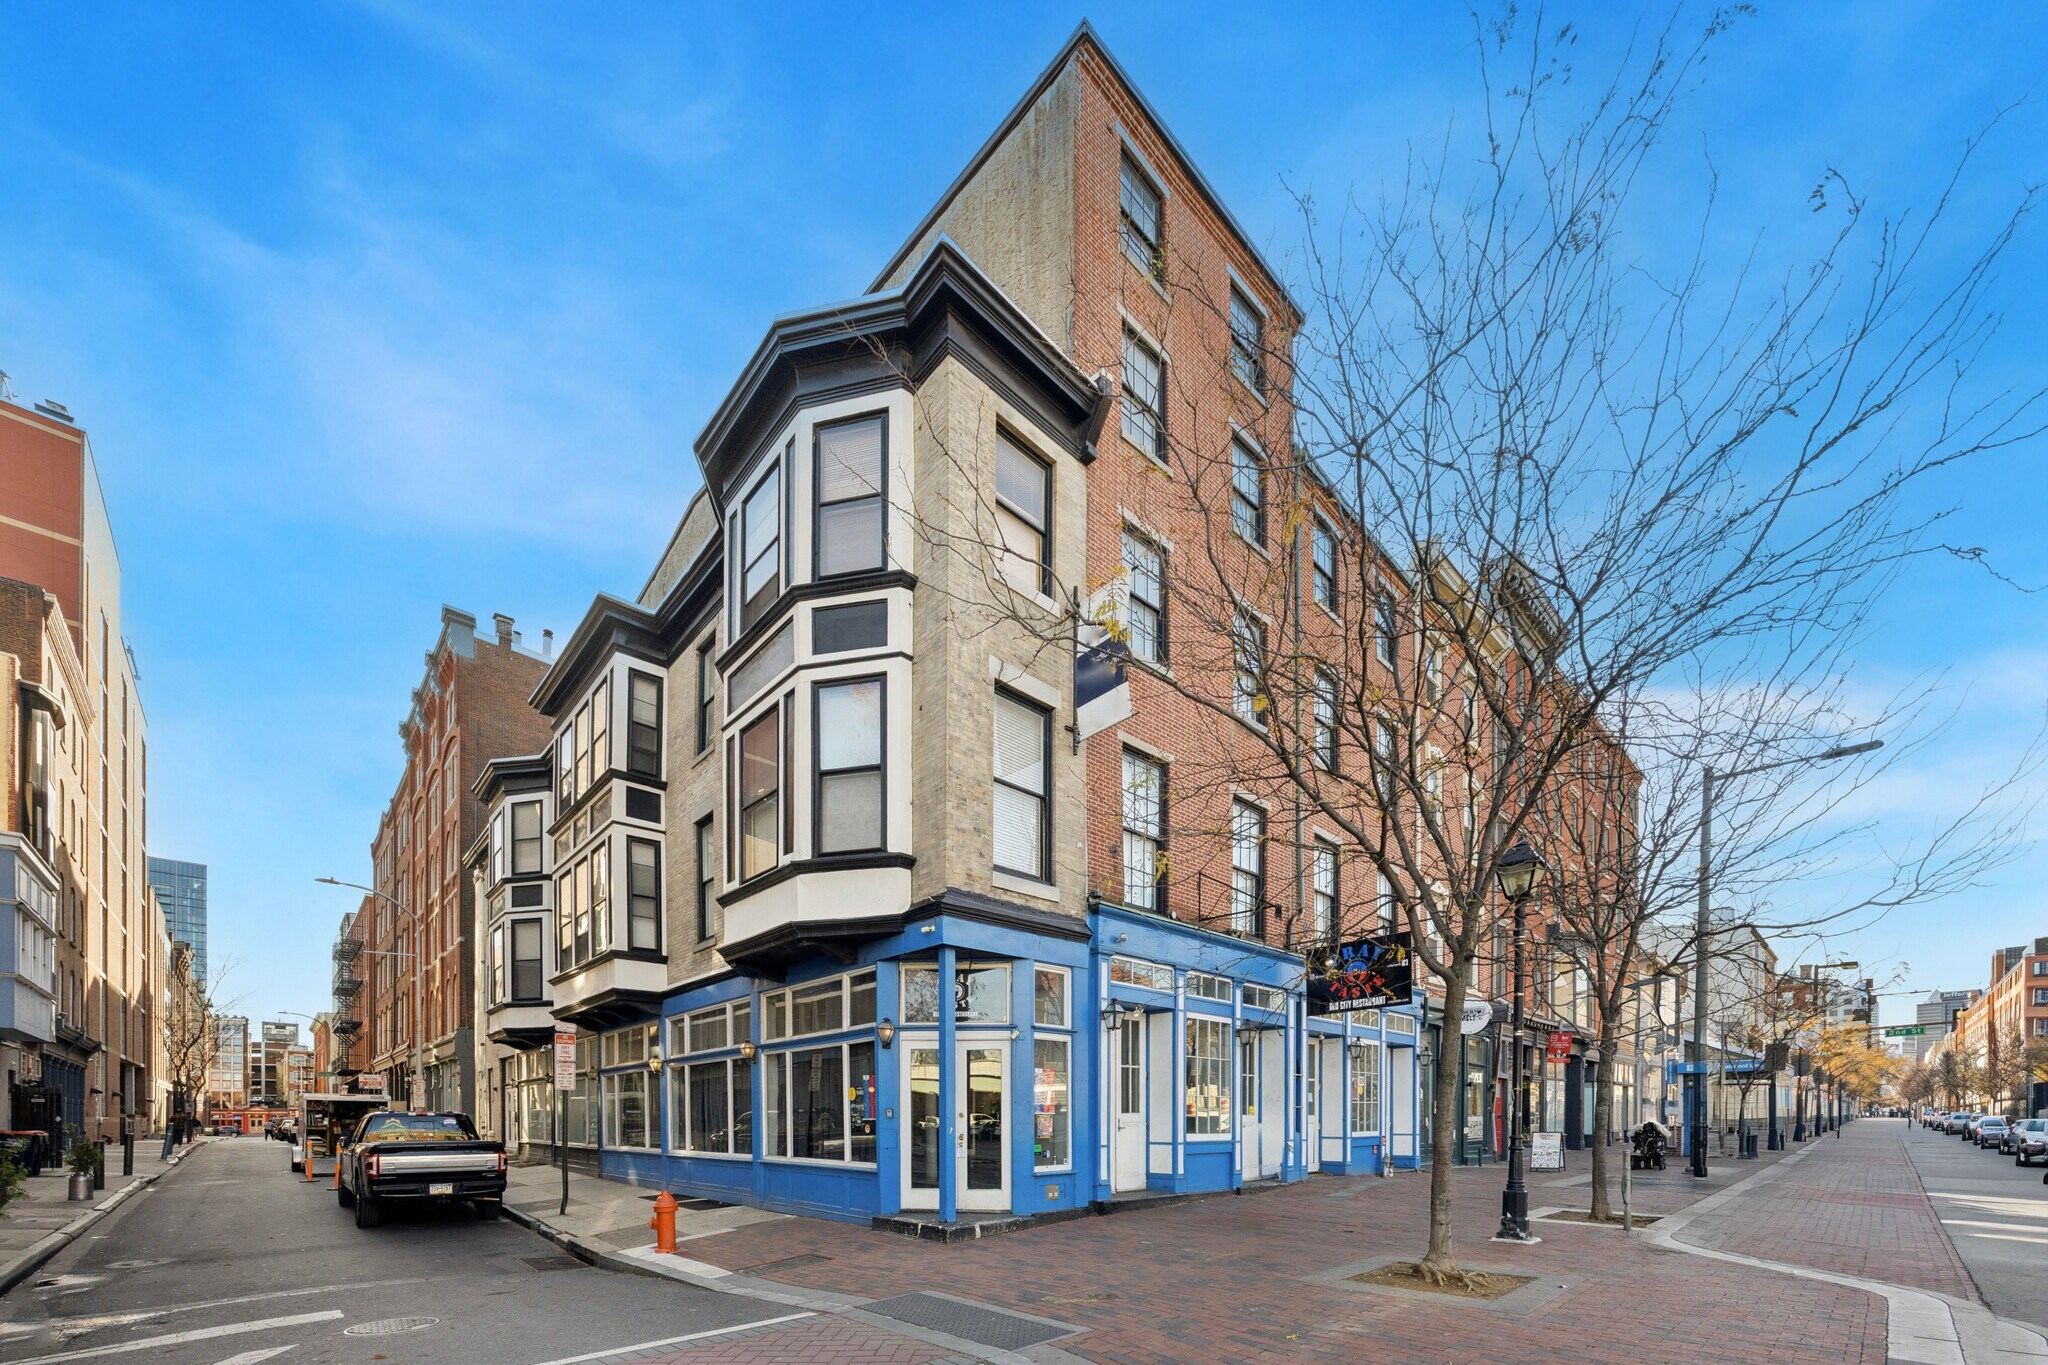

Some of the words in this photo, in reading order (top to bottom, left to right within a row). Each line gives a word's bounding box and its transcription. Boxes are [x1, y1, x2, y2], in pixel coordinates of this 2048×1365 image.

[1330, 974, 1386, 998] TASTE
[1329, 1003, 1339, 1011] OLD
[1340, 1000, 1352, 1009] CITY
[1353, 996, 1386, 1008] RESTAURANT
